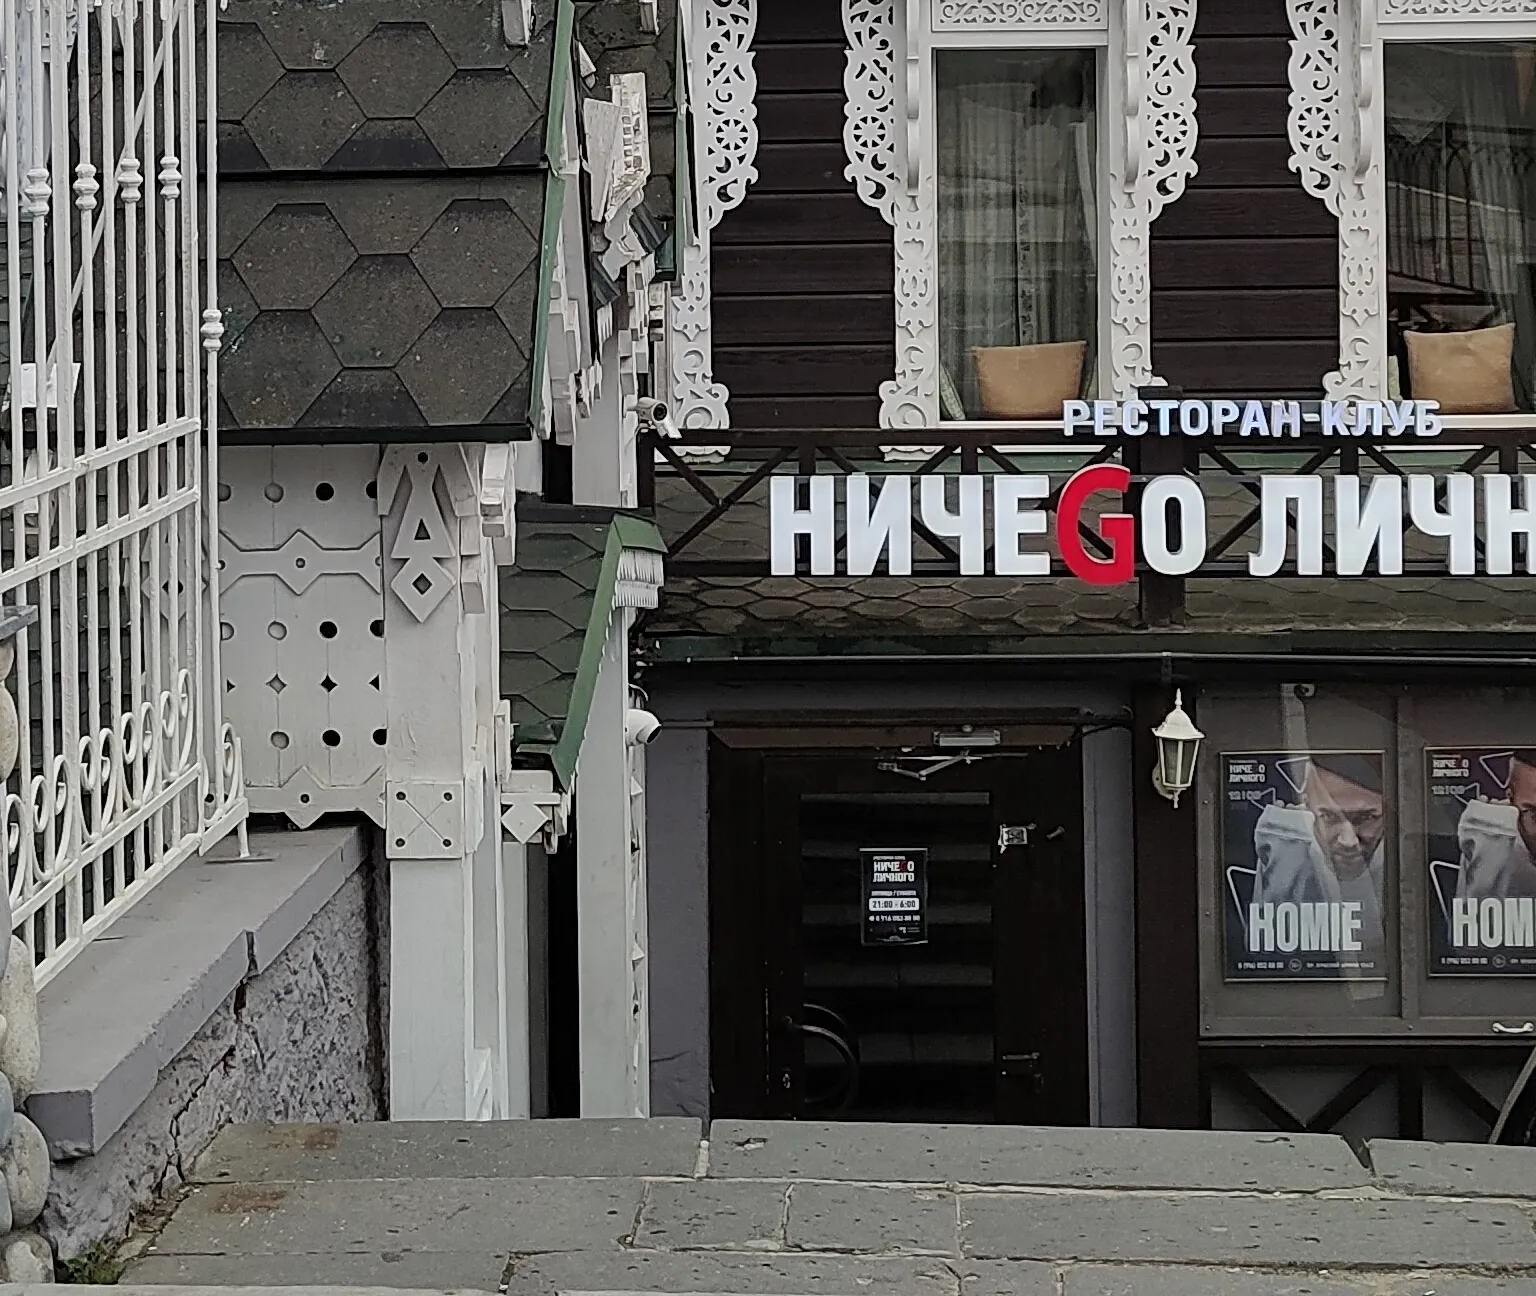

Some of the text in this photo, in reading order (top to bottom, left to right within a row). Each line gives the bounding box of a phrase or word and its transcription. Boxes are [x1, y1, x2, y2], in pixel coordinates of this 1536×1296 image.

[1063, 398, 1443, 438] РЕСТОРАН-КЛУБ
[770, 462, 1208, 586] НИЧЕGО
[873, 873, 914, 882] ЛИЧНОГО
[872, 900, 893, 908] 21:00
[899, 899, 916, 908] 6:00
[1249, 901, 1362, 952] HOMIE
